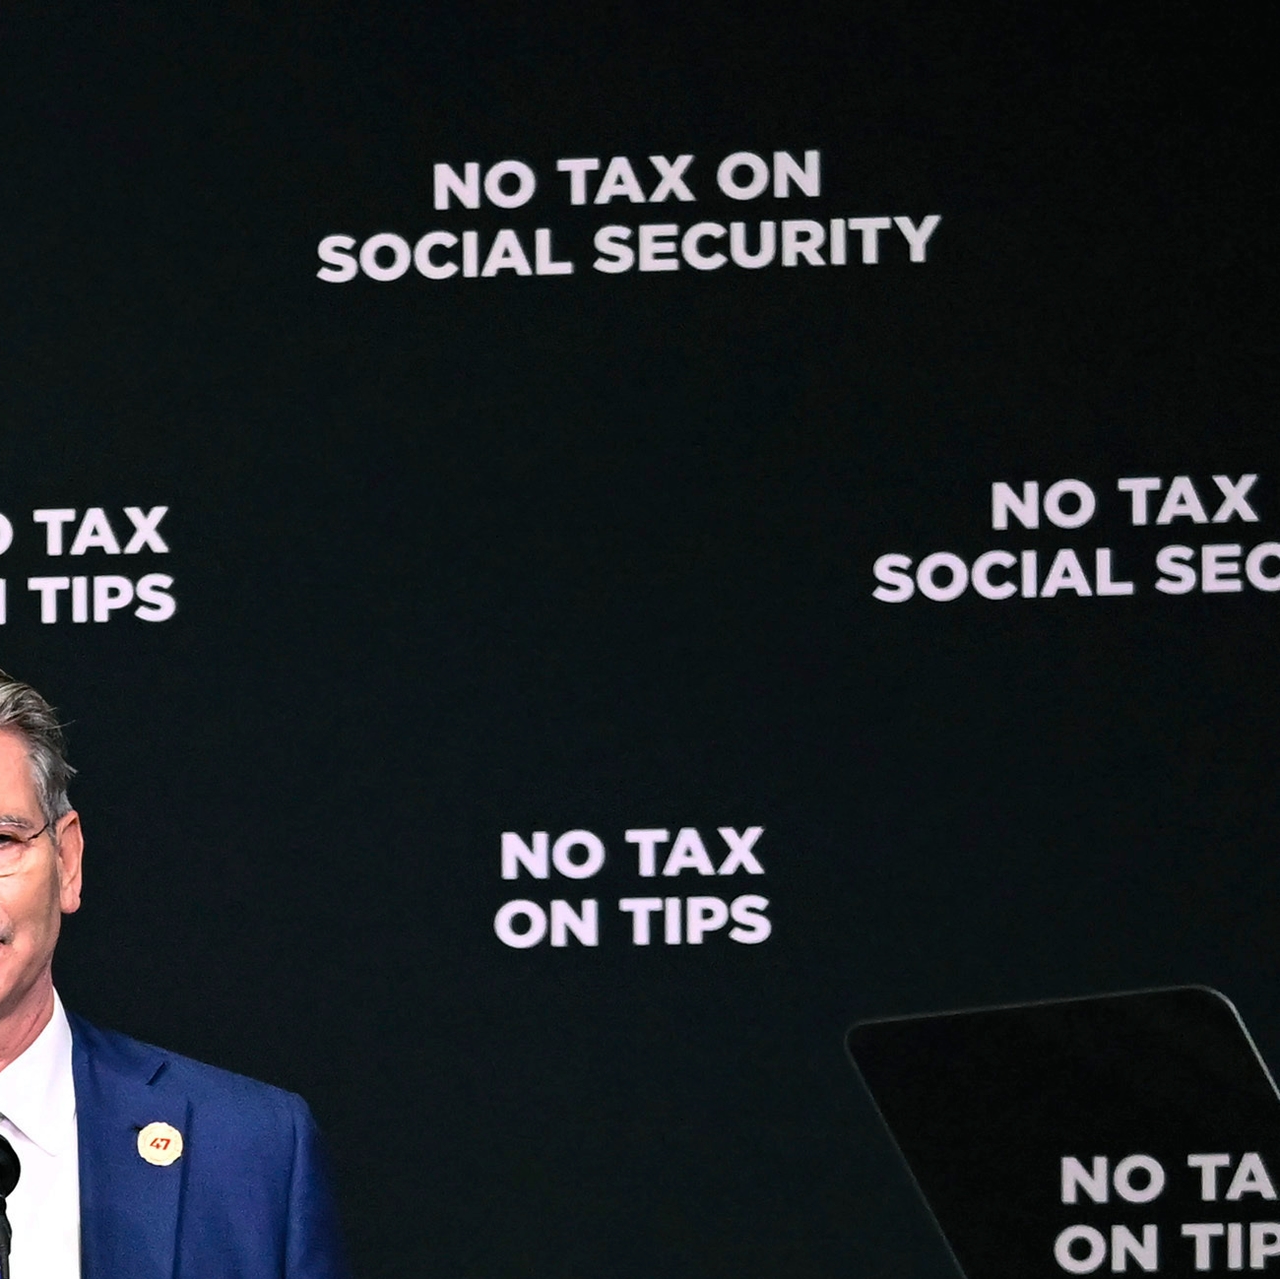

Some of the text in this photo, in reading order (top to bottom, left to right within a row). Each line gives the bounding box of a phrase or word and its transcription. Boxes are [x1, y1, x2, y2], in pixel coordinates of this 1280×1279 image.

[432, 148, 822, 212] NO TAX ON
[315, 213, 942, 284] SOCIAL SECURITY
[990, 472, 1260, 532] NO TAX
[31, 504, 170, 557] TAX
[26, 571, 178, 625] TIPS
[871, 546, 1135, 604] SOCIAL
[500, 825, 766, 881] NO TAX
[492, 893, 773, 950] ON TIPS
[149, 1137, 172, 1151] 47
[1060, 1151, 1278, 1205] NO TA
[1053, 1223, 1159, 1275] ON
